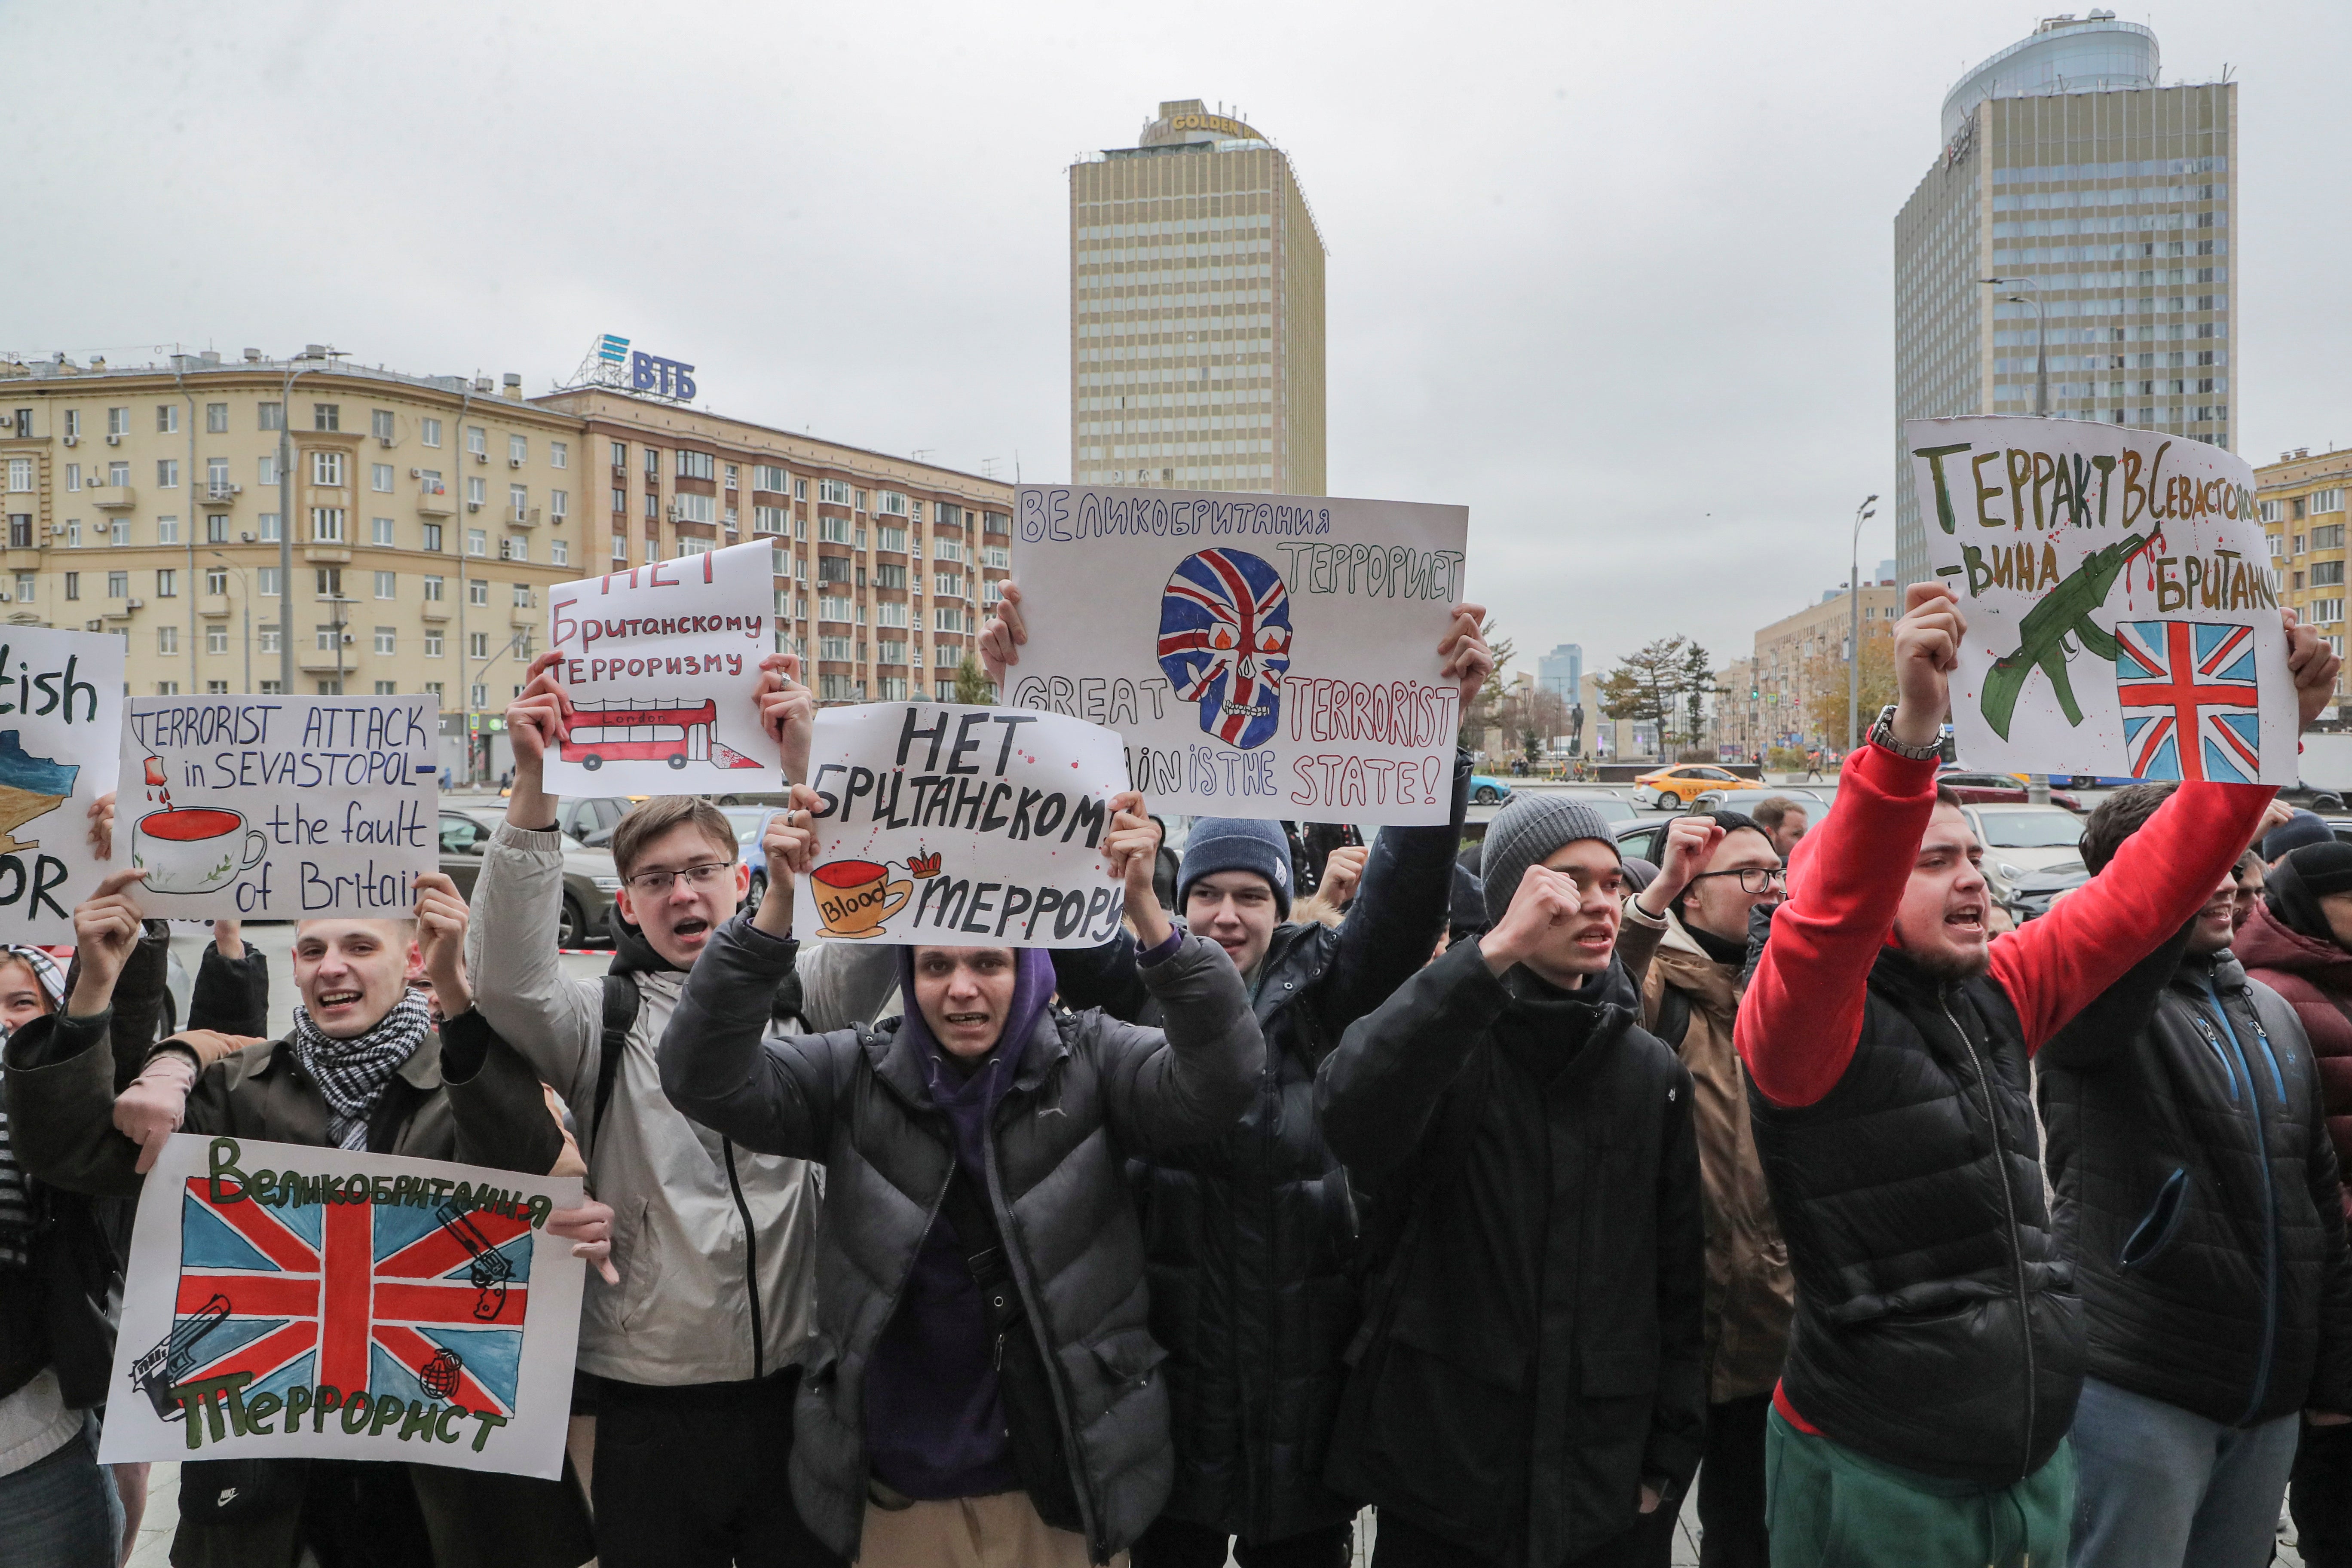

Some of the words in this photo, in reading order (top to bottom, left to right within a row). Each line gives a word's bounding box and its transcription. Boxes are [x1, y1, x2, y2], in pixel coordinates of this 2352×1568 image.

[1172, 115, 1238, 137] GOLDEN
[633, 351, 696, 399] ВТБ
[1912, 442, 2116, 535] ТЕРРАКТ
[1020, 490, 1330, 543] ВЕЛИКОБРИТАНИЯ
[1276, 542, 1464, 603] ТЕРРОРИСТ
[552, 653, 743, 685] ТЕРРОРИЗМУ
[603, 713, 667, 724] London
[1012, 675, 1168, 725] GREAT
[131, 704, 282, 749] TERRORIST
[302, 705, 426, 750] ATTACK
[895, 707, 1038, 776] НЕТ
[184, 760, 205, 787] in
[1216, 750, 1277, 796] THE
[1290, 755, 1441, 807] STATE!
[265, 802, 329, 845] the
[341, 800, 427, 847] fault
[810, 764, 1114, 849] БРИТАНСКОМ
[236, 861, 272, 913] of
[821, 881, 886, 924] Blood
[220, 1487, 236, 1500] NIKE
